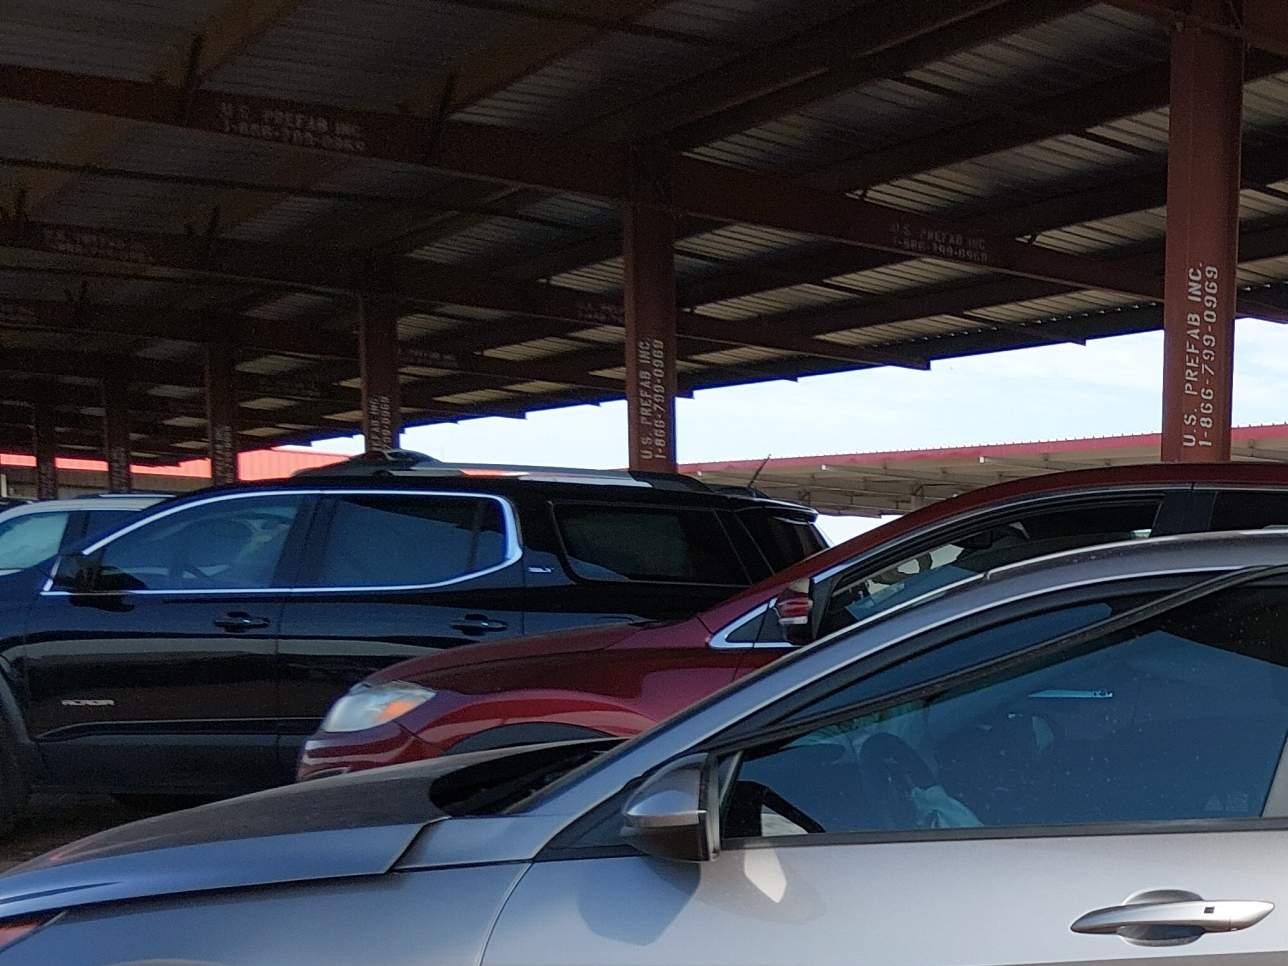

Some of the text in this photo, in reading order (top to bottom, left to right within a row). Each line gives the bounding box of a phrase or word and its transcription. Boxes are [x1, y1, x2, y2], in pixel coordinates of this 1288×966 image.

[640, 370, 652, 426] PREFAB
[1183, 262, 1203, 447] U.S. PREFAB INC.
[1199, 266, 1218, 447] 1-866-799-0969
[640, 432, 653, 460] U.S.
